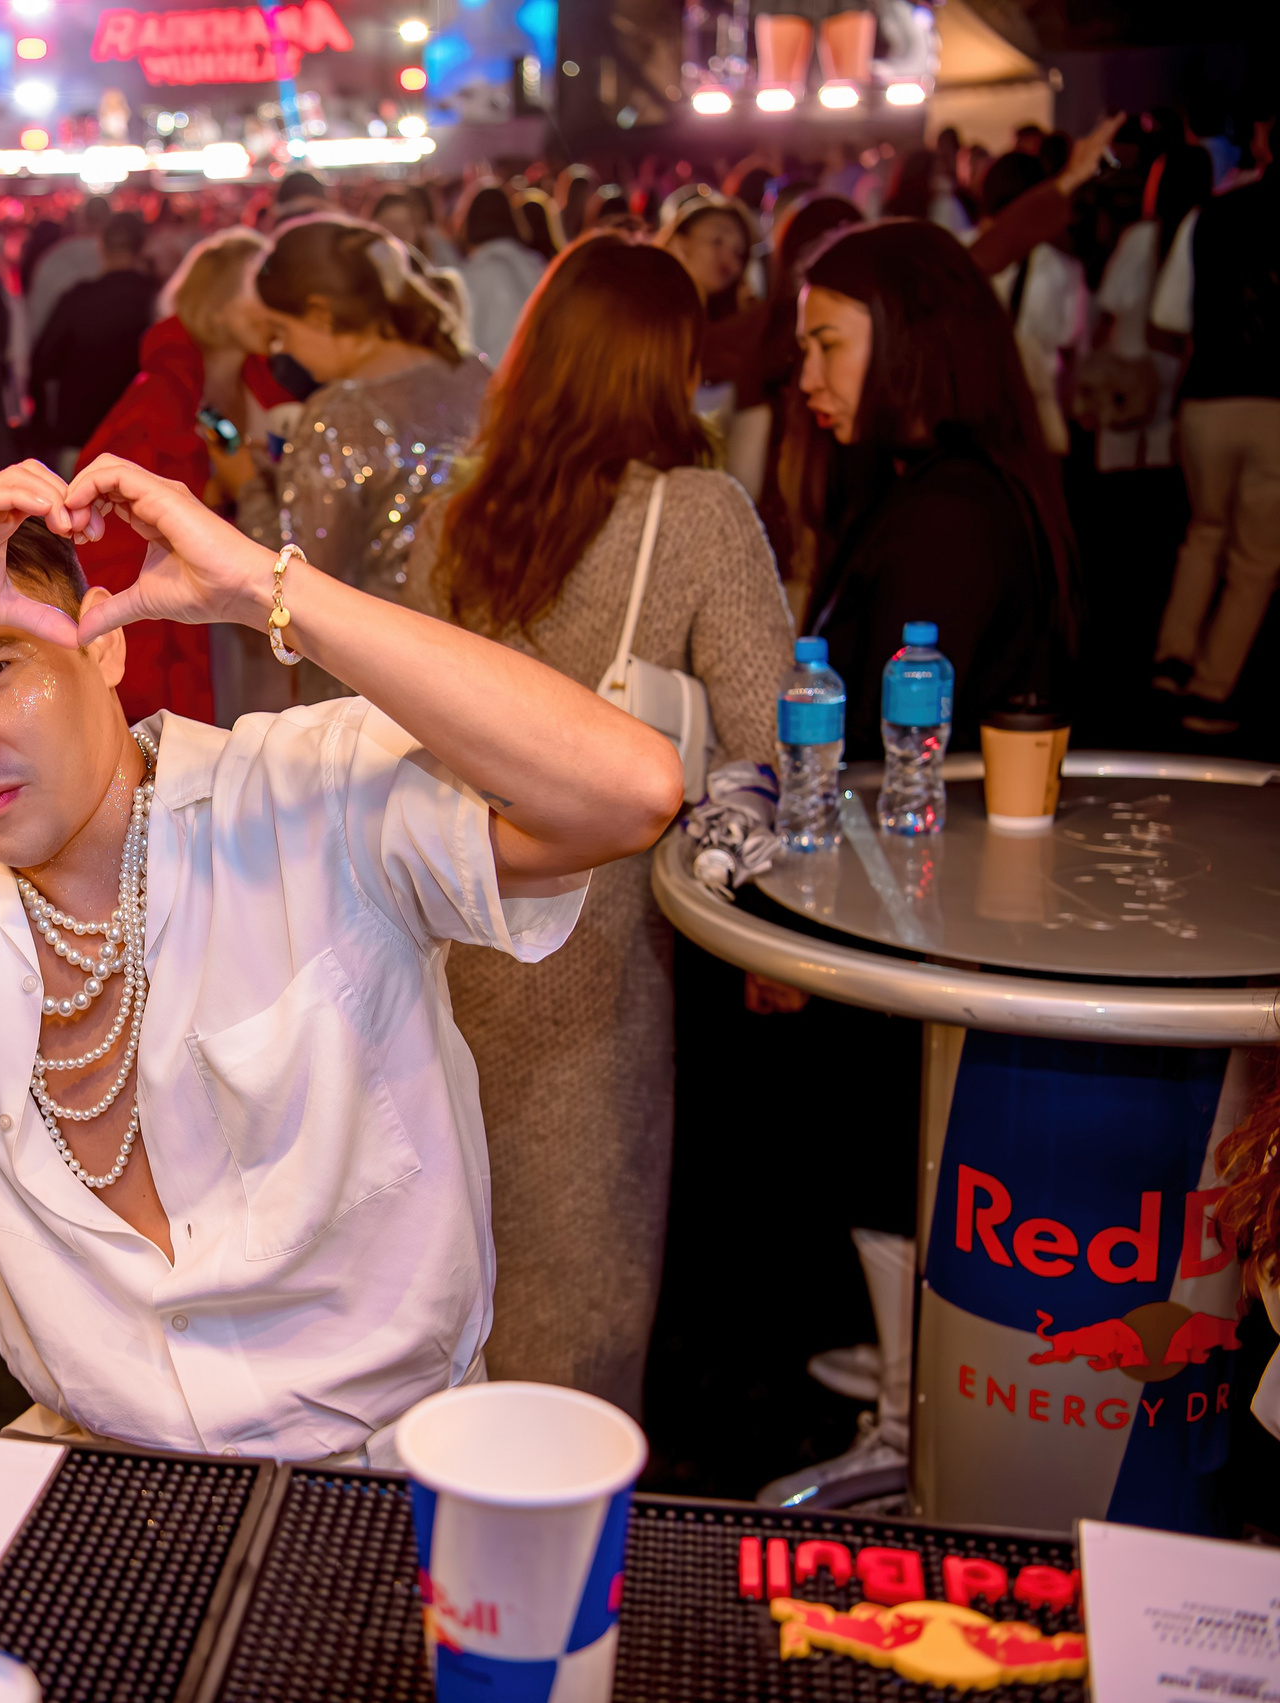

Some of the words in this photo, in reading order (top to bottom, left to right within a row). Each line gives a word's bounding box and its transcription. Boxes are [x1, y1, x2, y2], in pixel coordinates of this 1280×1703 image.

[955, 1163, 1162, 1284] Red
[958, 1364, 1164, 1431] ENERGY
[739, 1536, 926, 1605] Bull
